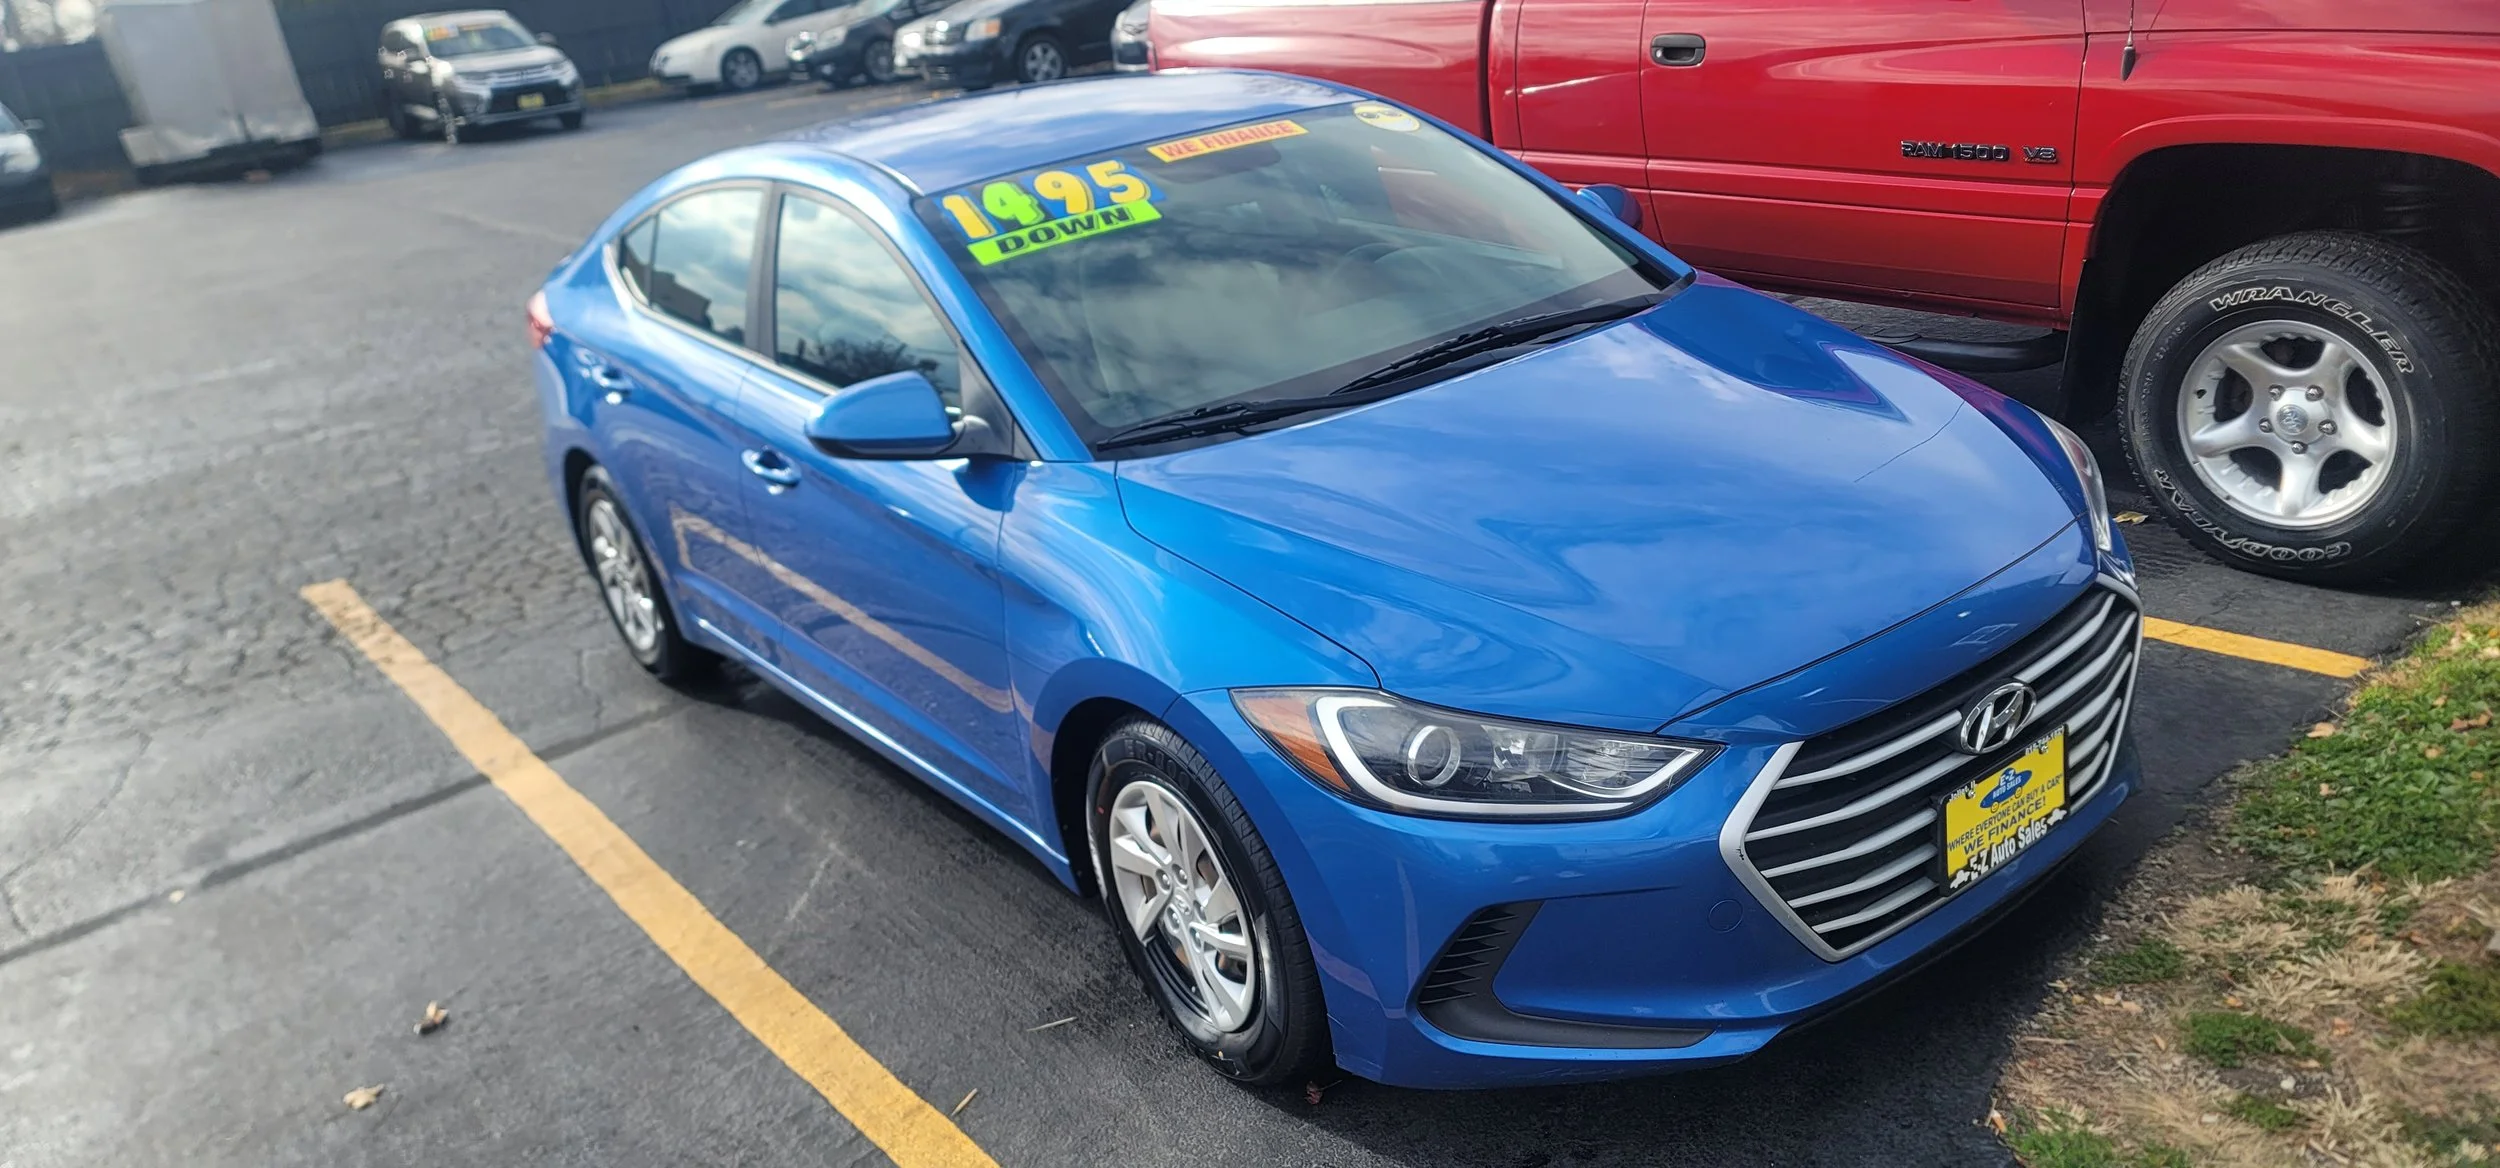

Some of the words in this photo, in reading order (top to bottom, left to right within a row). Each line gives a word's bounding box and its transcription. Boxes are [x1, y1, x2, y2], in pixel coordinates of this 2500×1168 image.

[1160, 136, 1202, 160] WE
[1202, 121, 1295, 153] FINANCE
[1901, 140, 1945, 158] RAM
[1951, 143, 2010, 162] 1500
[2023, 146, 2057, 159] V8
[942, 159, 1152, 240] 1495
[998, 207, 1137, 255] DOWN
[2209, 286, 2415, 374] WRANGLER
[2153, 468, 2352, 562] GOODYEAR
[1992, 786, 2007, 800] AUTO
[2006, 776, 2022, 792] SALES
[1999, 769, 2016, 787] E-Z
[1963, 835, 1985, 856] WE
[1988, 795, 2047, 841] FINANCE!
[1975, 807, 2011, 835] EVERYONE
[2012, 799, 2026, 813] CAN
[2026, 789, 2039, 805] BUY
[1990, 836, 2016, 868] Auto
[2017, 817, 2048, 849] Sales
